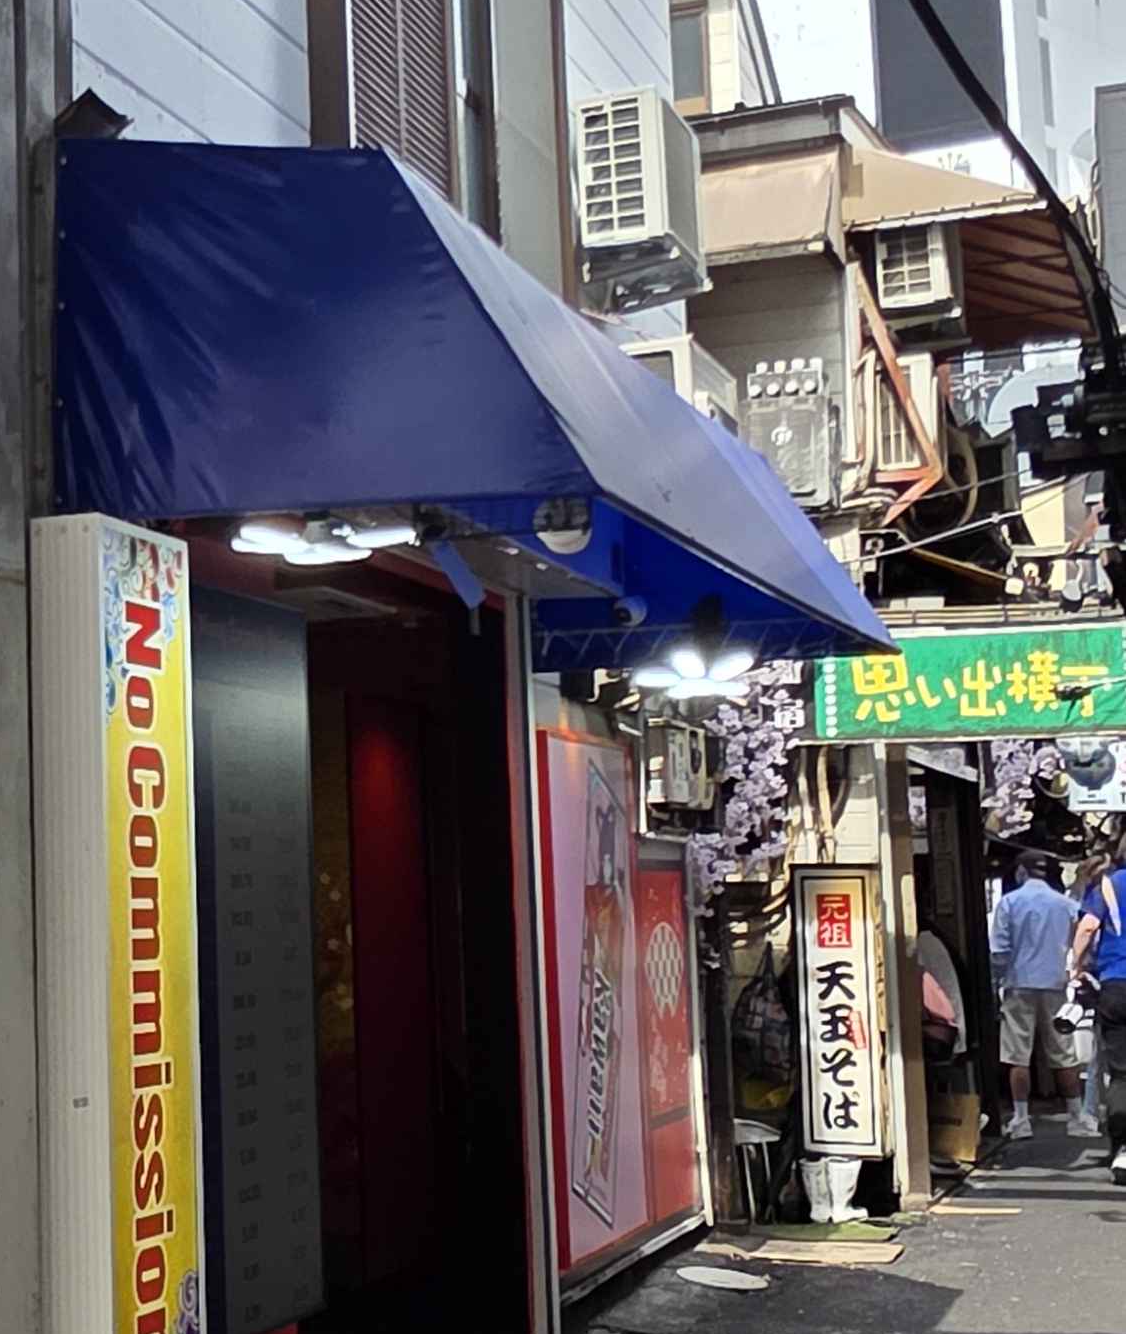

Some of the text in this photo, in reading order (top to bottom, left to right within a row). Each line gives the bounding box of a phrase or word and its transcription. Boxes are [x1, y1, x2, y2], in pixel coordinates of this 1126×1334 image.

[124, 599, 164, 733] No
[850, 652, 1110, 723] 思い出横丁
[819, 896, 851, 947] 元祖
[815, 960, 860, 1130] 天玉そば
